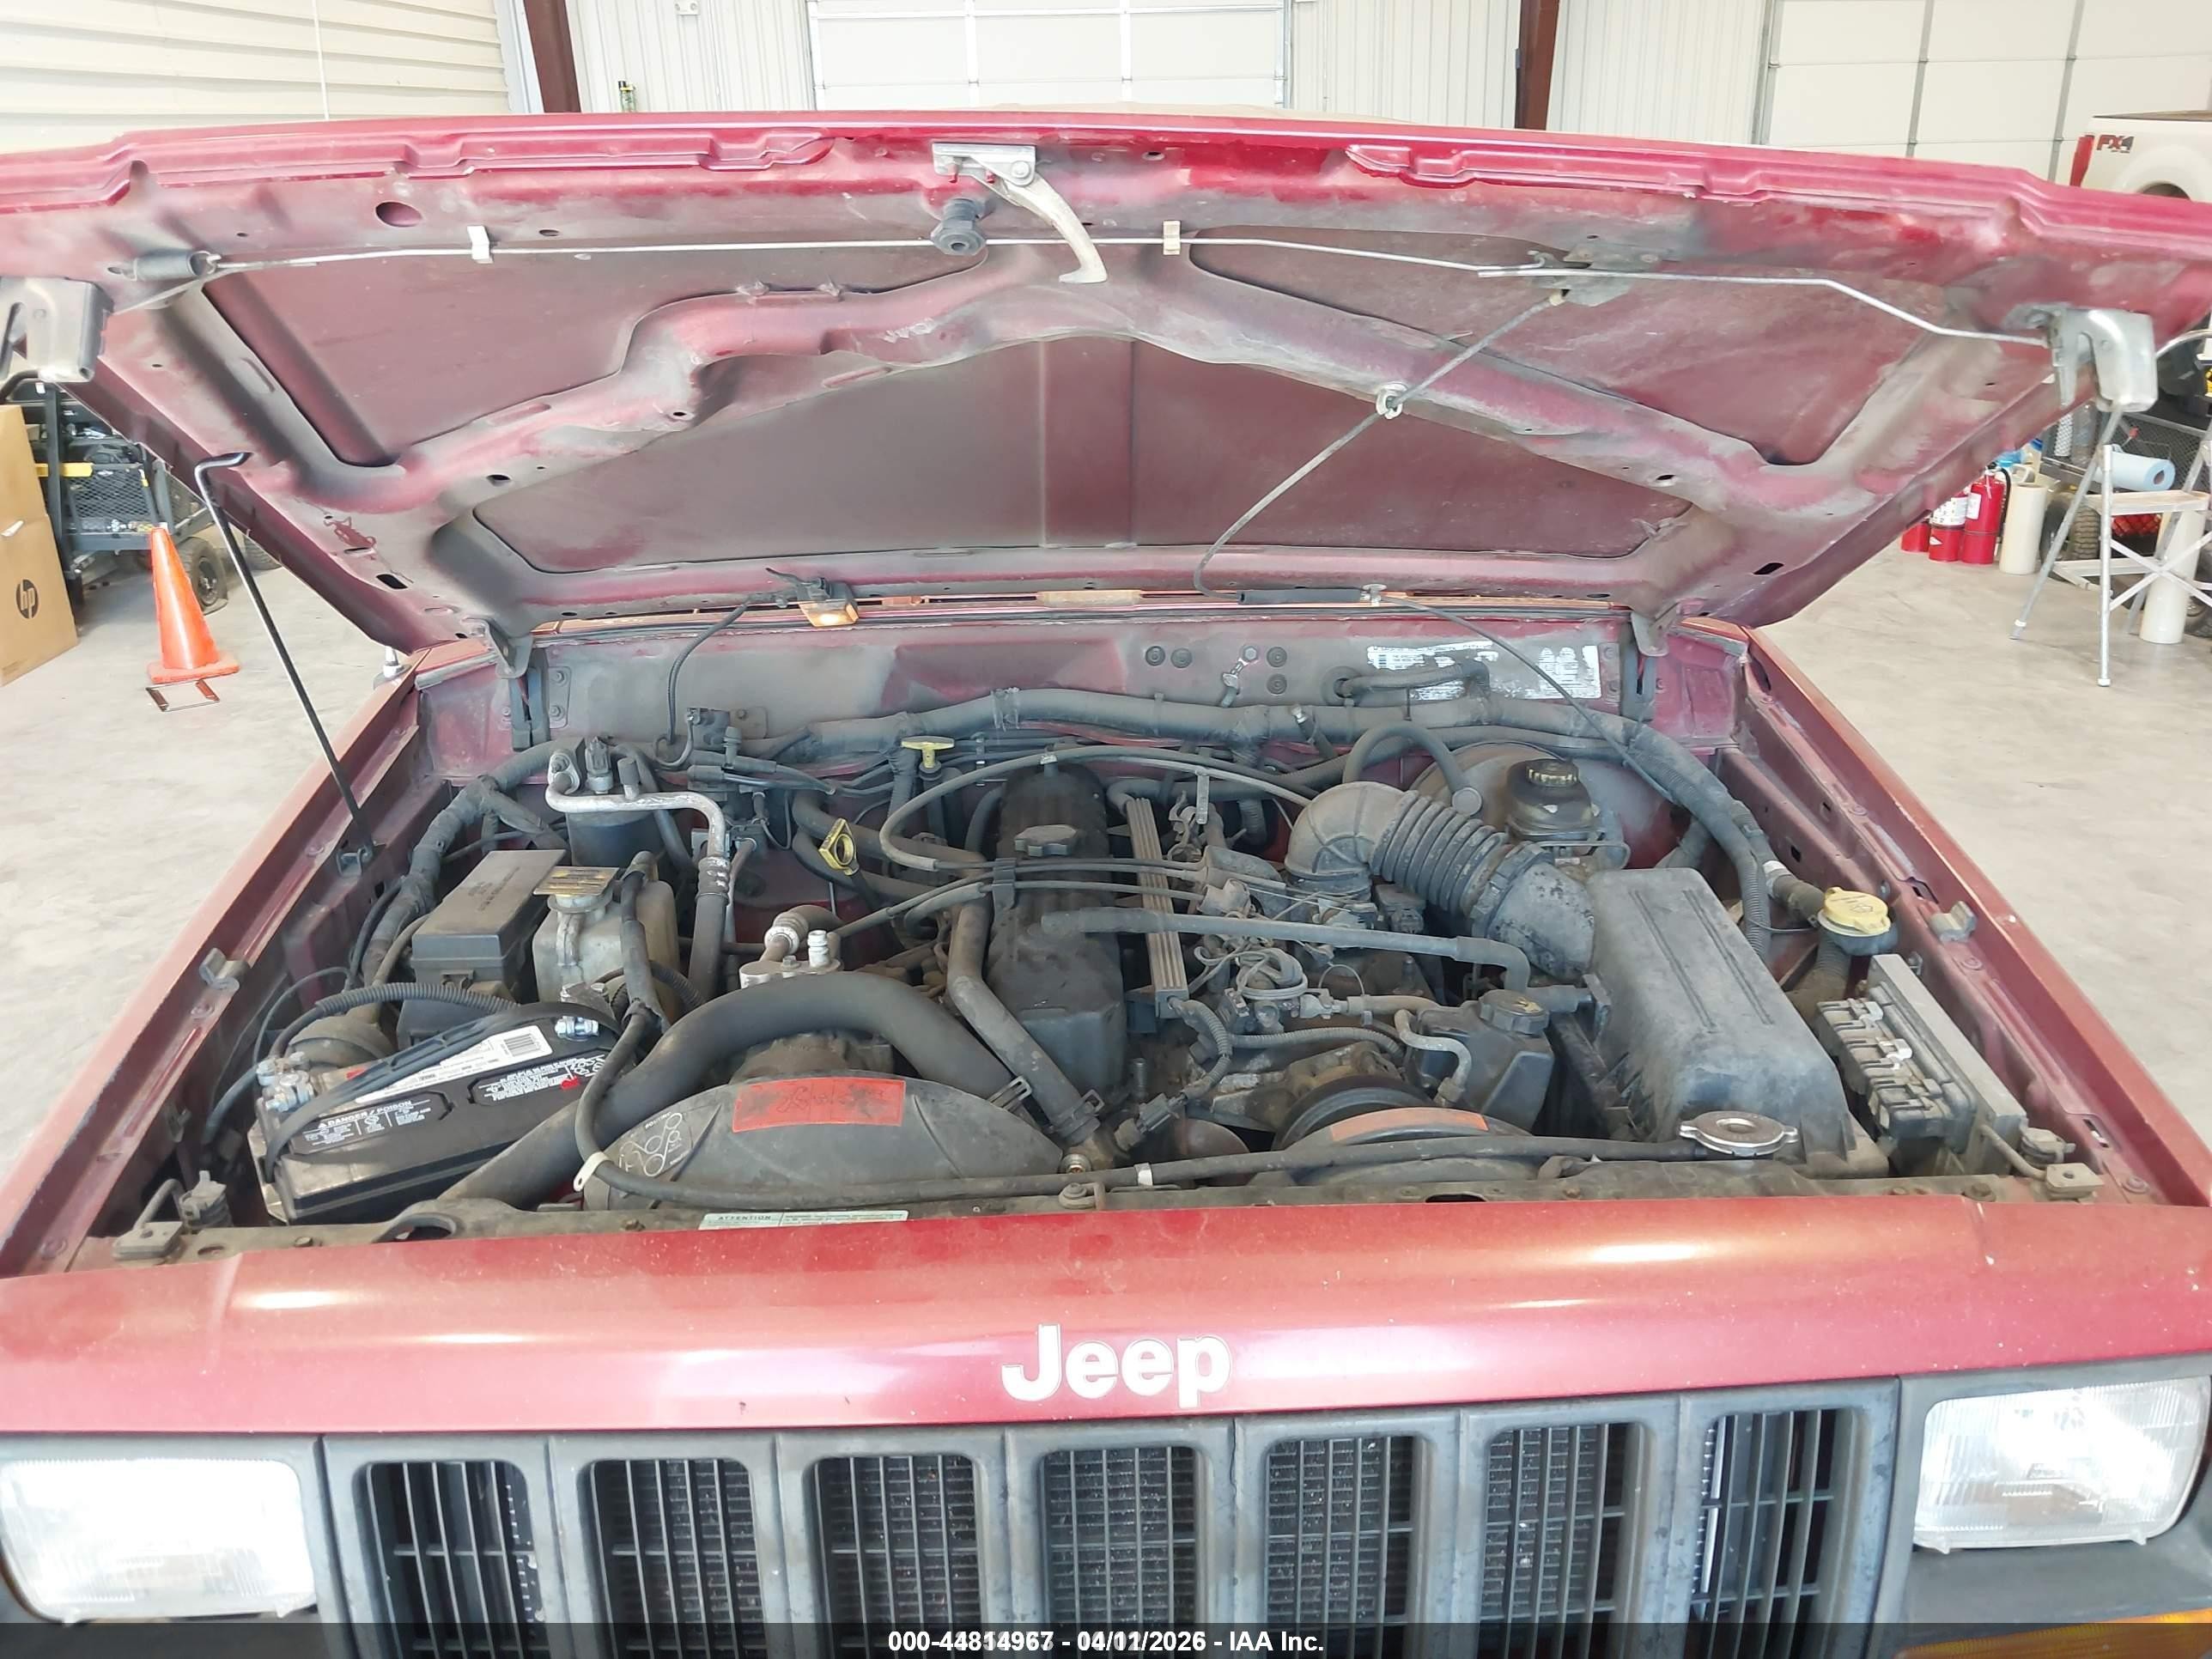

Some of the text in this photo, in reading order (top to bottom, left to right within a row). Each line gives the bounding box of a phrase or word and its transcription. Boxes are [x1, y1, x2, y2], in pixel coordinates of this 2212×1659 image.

[2096, 135, 2135, 150] FX4
[327, 1112, 368, 1127] DANGER
[1000, 1323, 1232, 1409] Jeep
